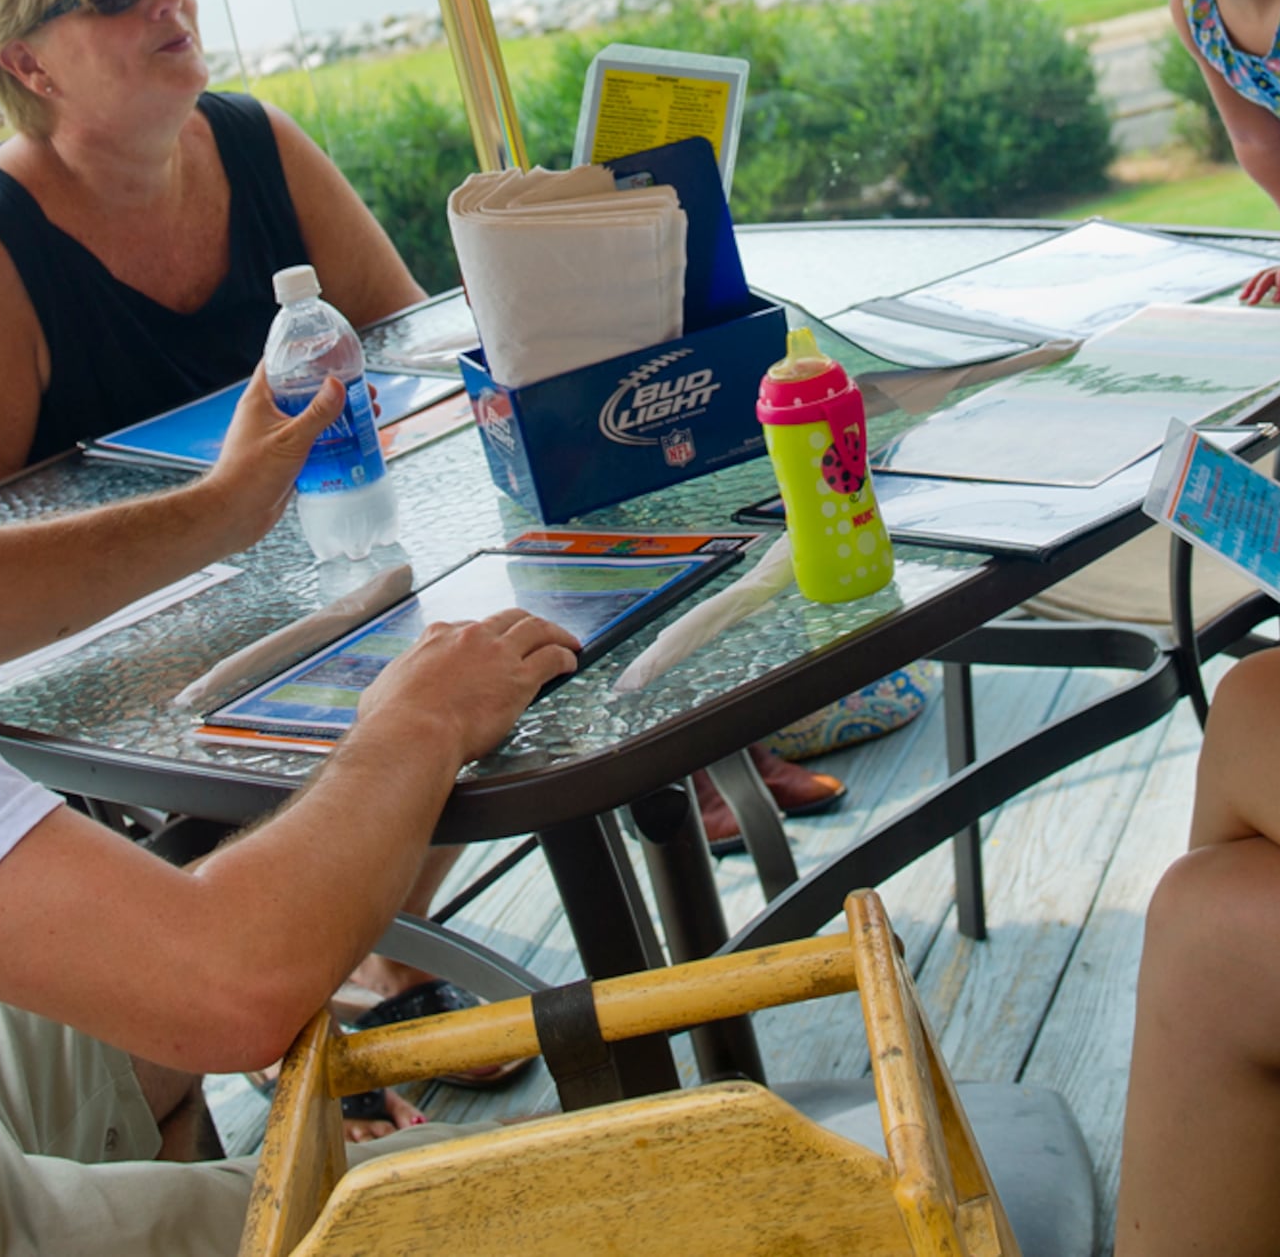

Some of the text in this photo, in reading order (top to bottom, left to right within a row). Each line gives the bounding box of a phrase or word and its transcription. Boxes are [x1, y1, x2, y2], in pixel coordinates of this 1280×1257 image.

[632, 368, 713, 409] BUD
[617, 382, 721, 430] LIGHT
[667, 442, 694, 463] NFL
[852, 508, 874, 529] NUK
